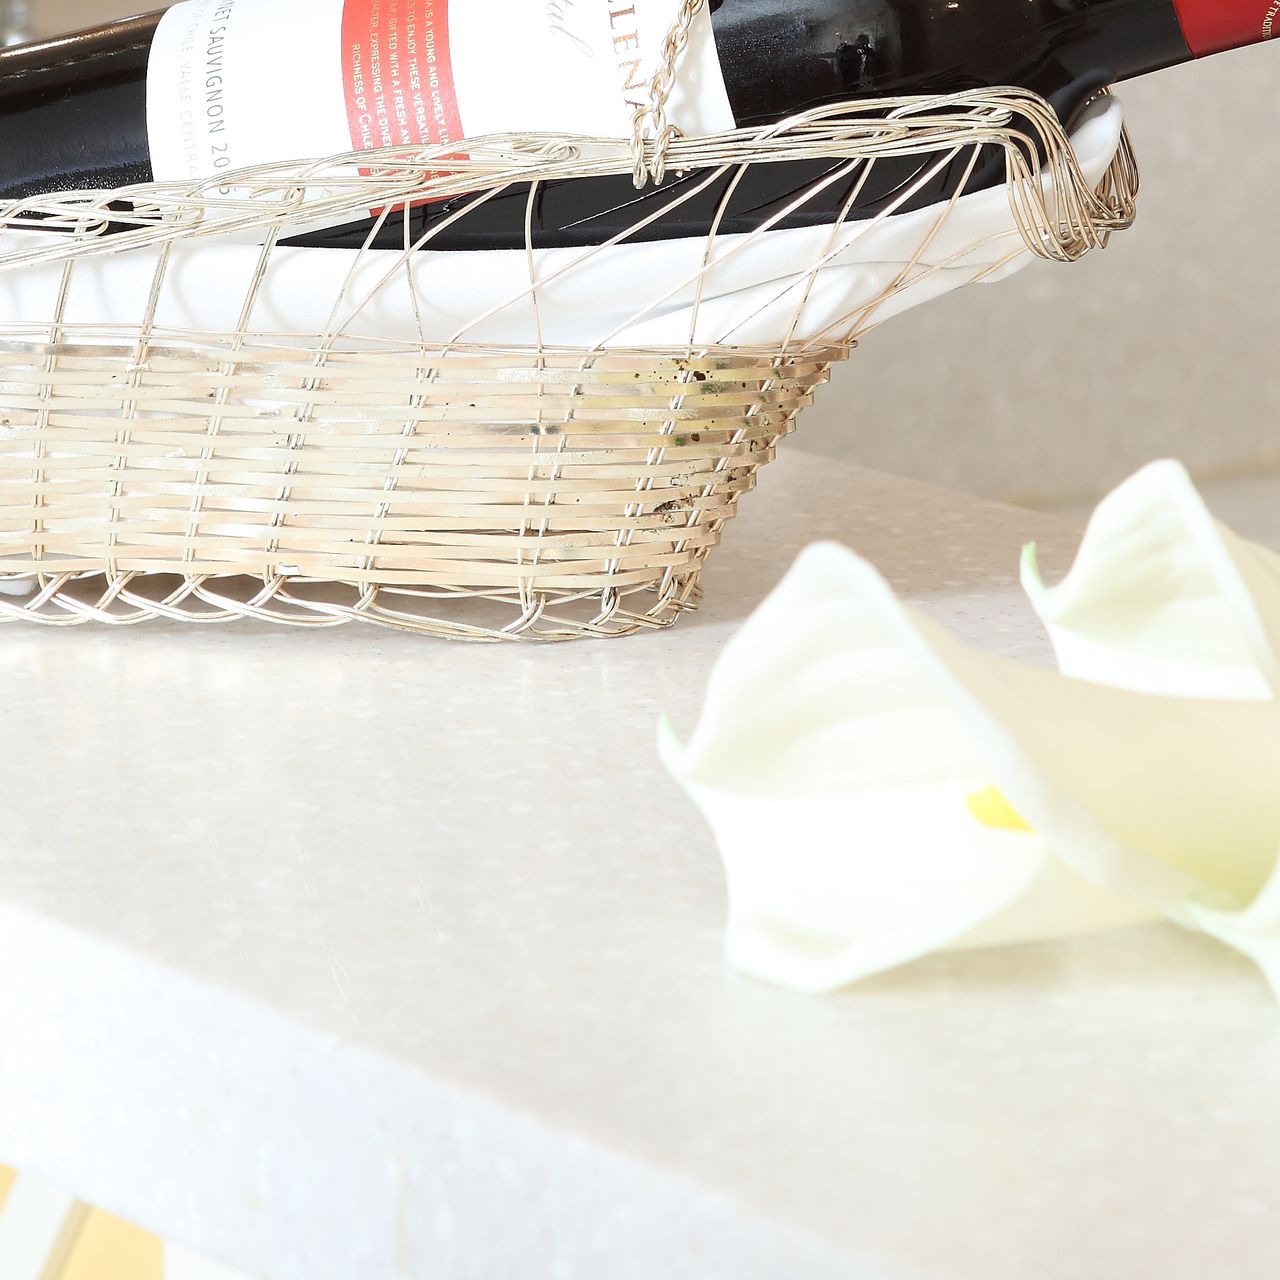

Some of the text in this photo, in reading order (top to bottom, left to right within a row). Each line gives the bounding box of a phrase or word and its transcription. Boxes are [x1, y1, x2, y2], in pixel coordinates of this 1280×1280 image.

[407, 23, 417, 55] ENJOY
[424, 28, 436, 64] YOUNG
[205, 26, 226, 134] SAUVIGNON
[351, 43, 364, 95] RICHNESS
[370, 33, 383, 94] EXPRESSING
[388, 53, 400, 78] WITH
[408, 57, 421, 91] THESE
[427, 65, 439, 88] AND
[391, 80, 401, 88] A
[355, 96, 367, 111] OF
[375, 94, 386, 116] THE
[393, 89, 407, 126] FRESH
[412, 93, 430, 144] VERSATIL
[431, 88, 447, 126] LIVELY
[180, 110, 199, 176] CENTRA
[400, 128, 411, 145] AN
[211, 143, 237, 195] 205
